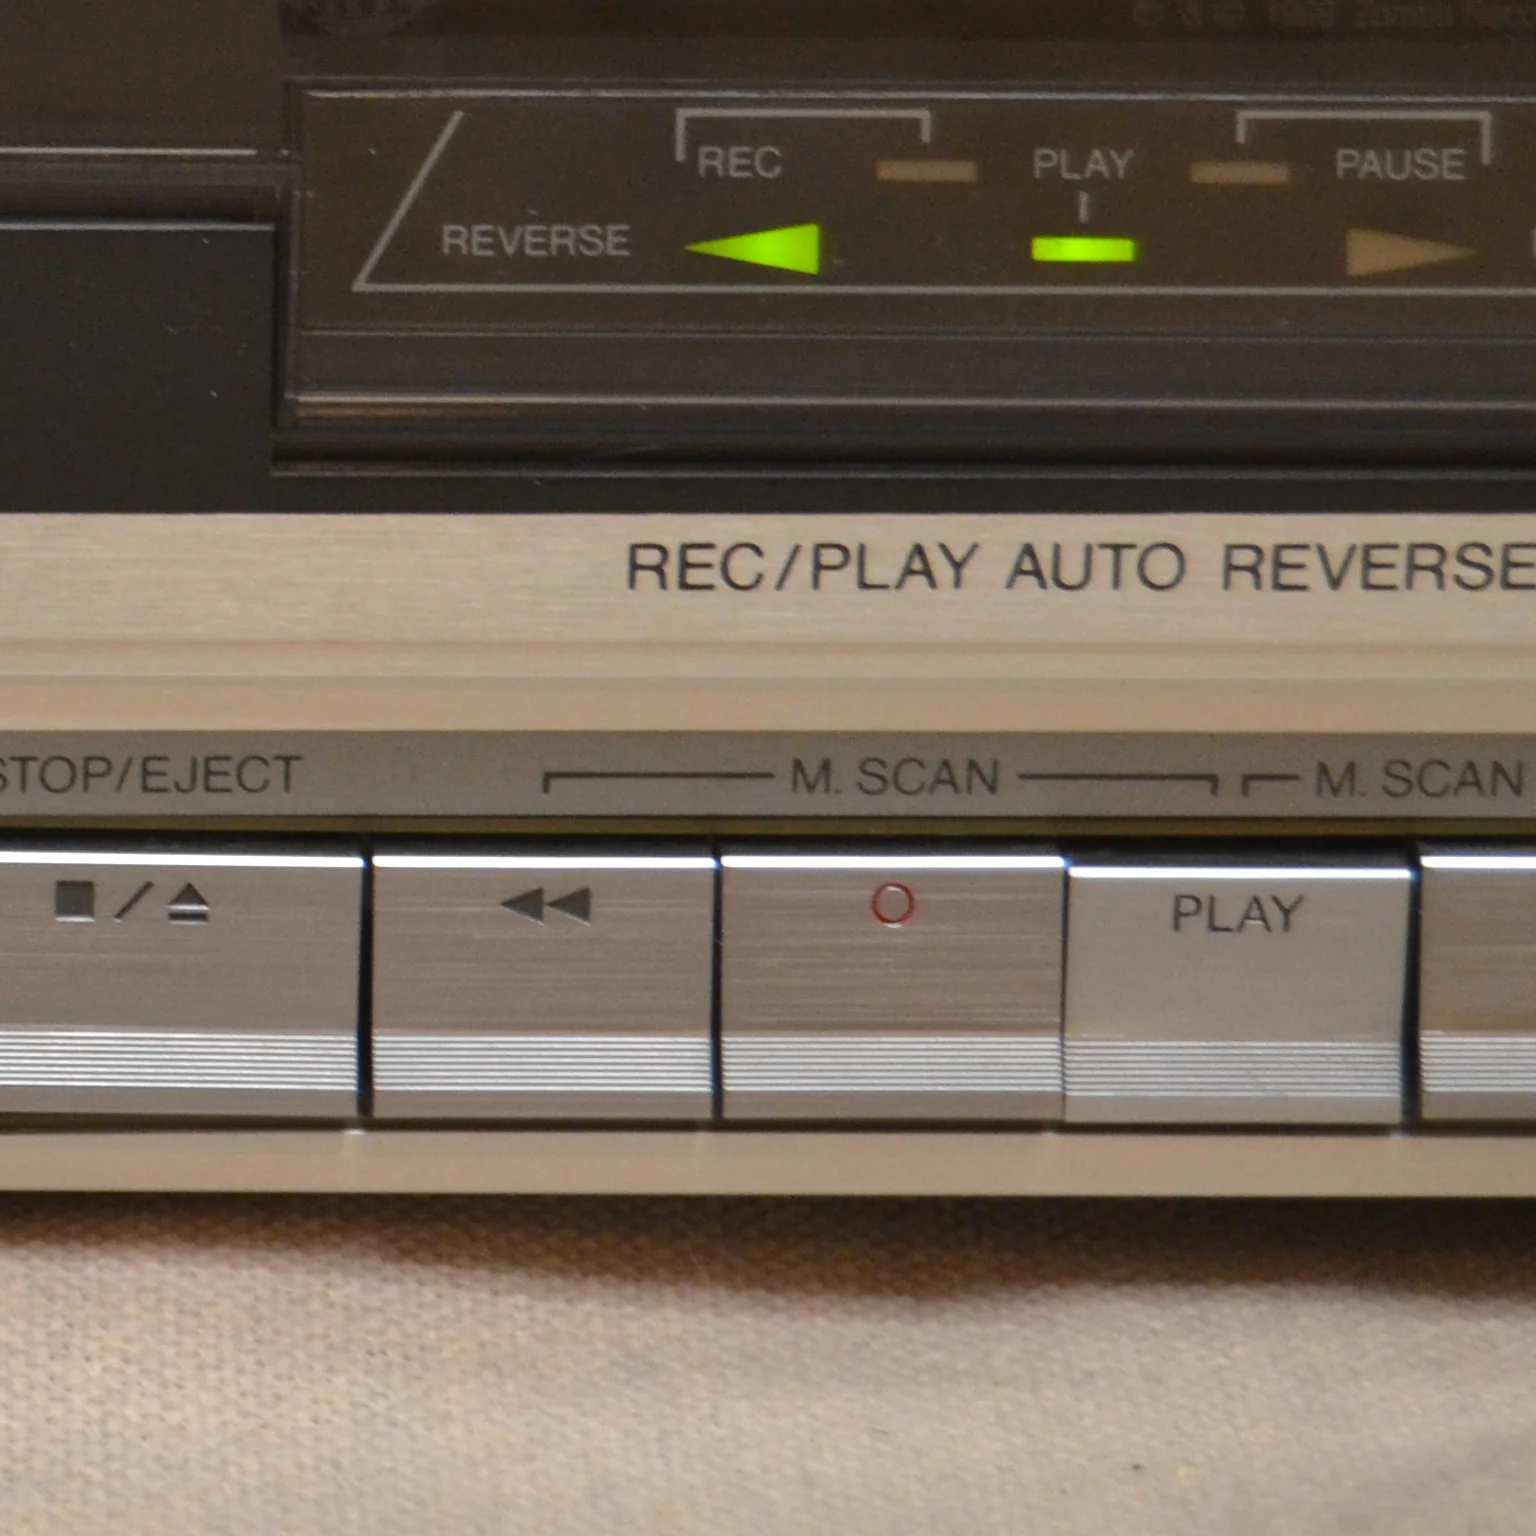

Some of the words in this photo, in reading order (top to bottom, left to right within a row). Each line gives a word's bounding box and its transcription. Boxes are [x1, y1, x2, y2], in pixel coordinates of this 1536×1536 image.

[699, 146, 782, 178] REC
[1034, 148, 1134, 180] PLAY
[1336, 148, 1466, 181] PAUSE
[442, 224, 630, 256] REVERSE
[628, 542, 979, 591] REC/PLAY
[1006, 542, 1186, 591] AUTO
[1223, 541, 1536, 592] REVERSE
[791, 757, 841, 795] M.
[857, 756, 1000, 795] SCAN
[1316, 760, 1366, 797] M.
[1382, 759, 1524, 798] SCAN
[1173, 894, 1304, 933] PLAY
